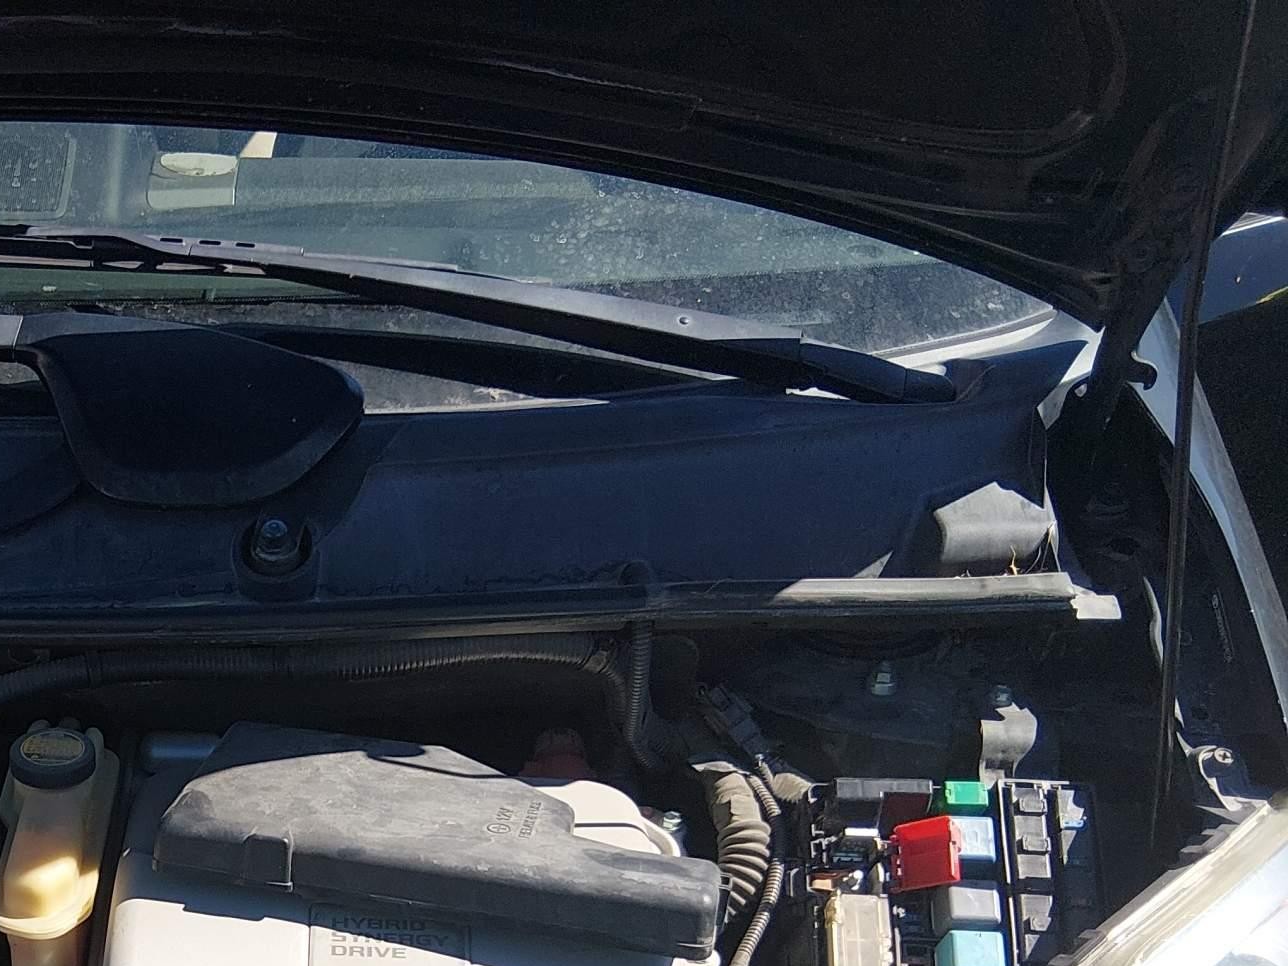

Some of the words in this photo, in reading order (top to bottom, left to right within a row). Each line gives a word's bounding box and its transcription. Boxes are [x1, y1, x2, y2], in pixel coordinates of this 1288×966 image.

[331, 917, 427, 931] HYBRID
[331, 931, 449, 947] SYNERGY
[330, 944, 407, 959] DRIVE
